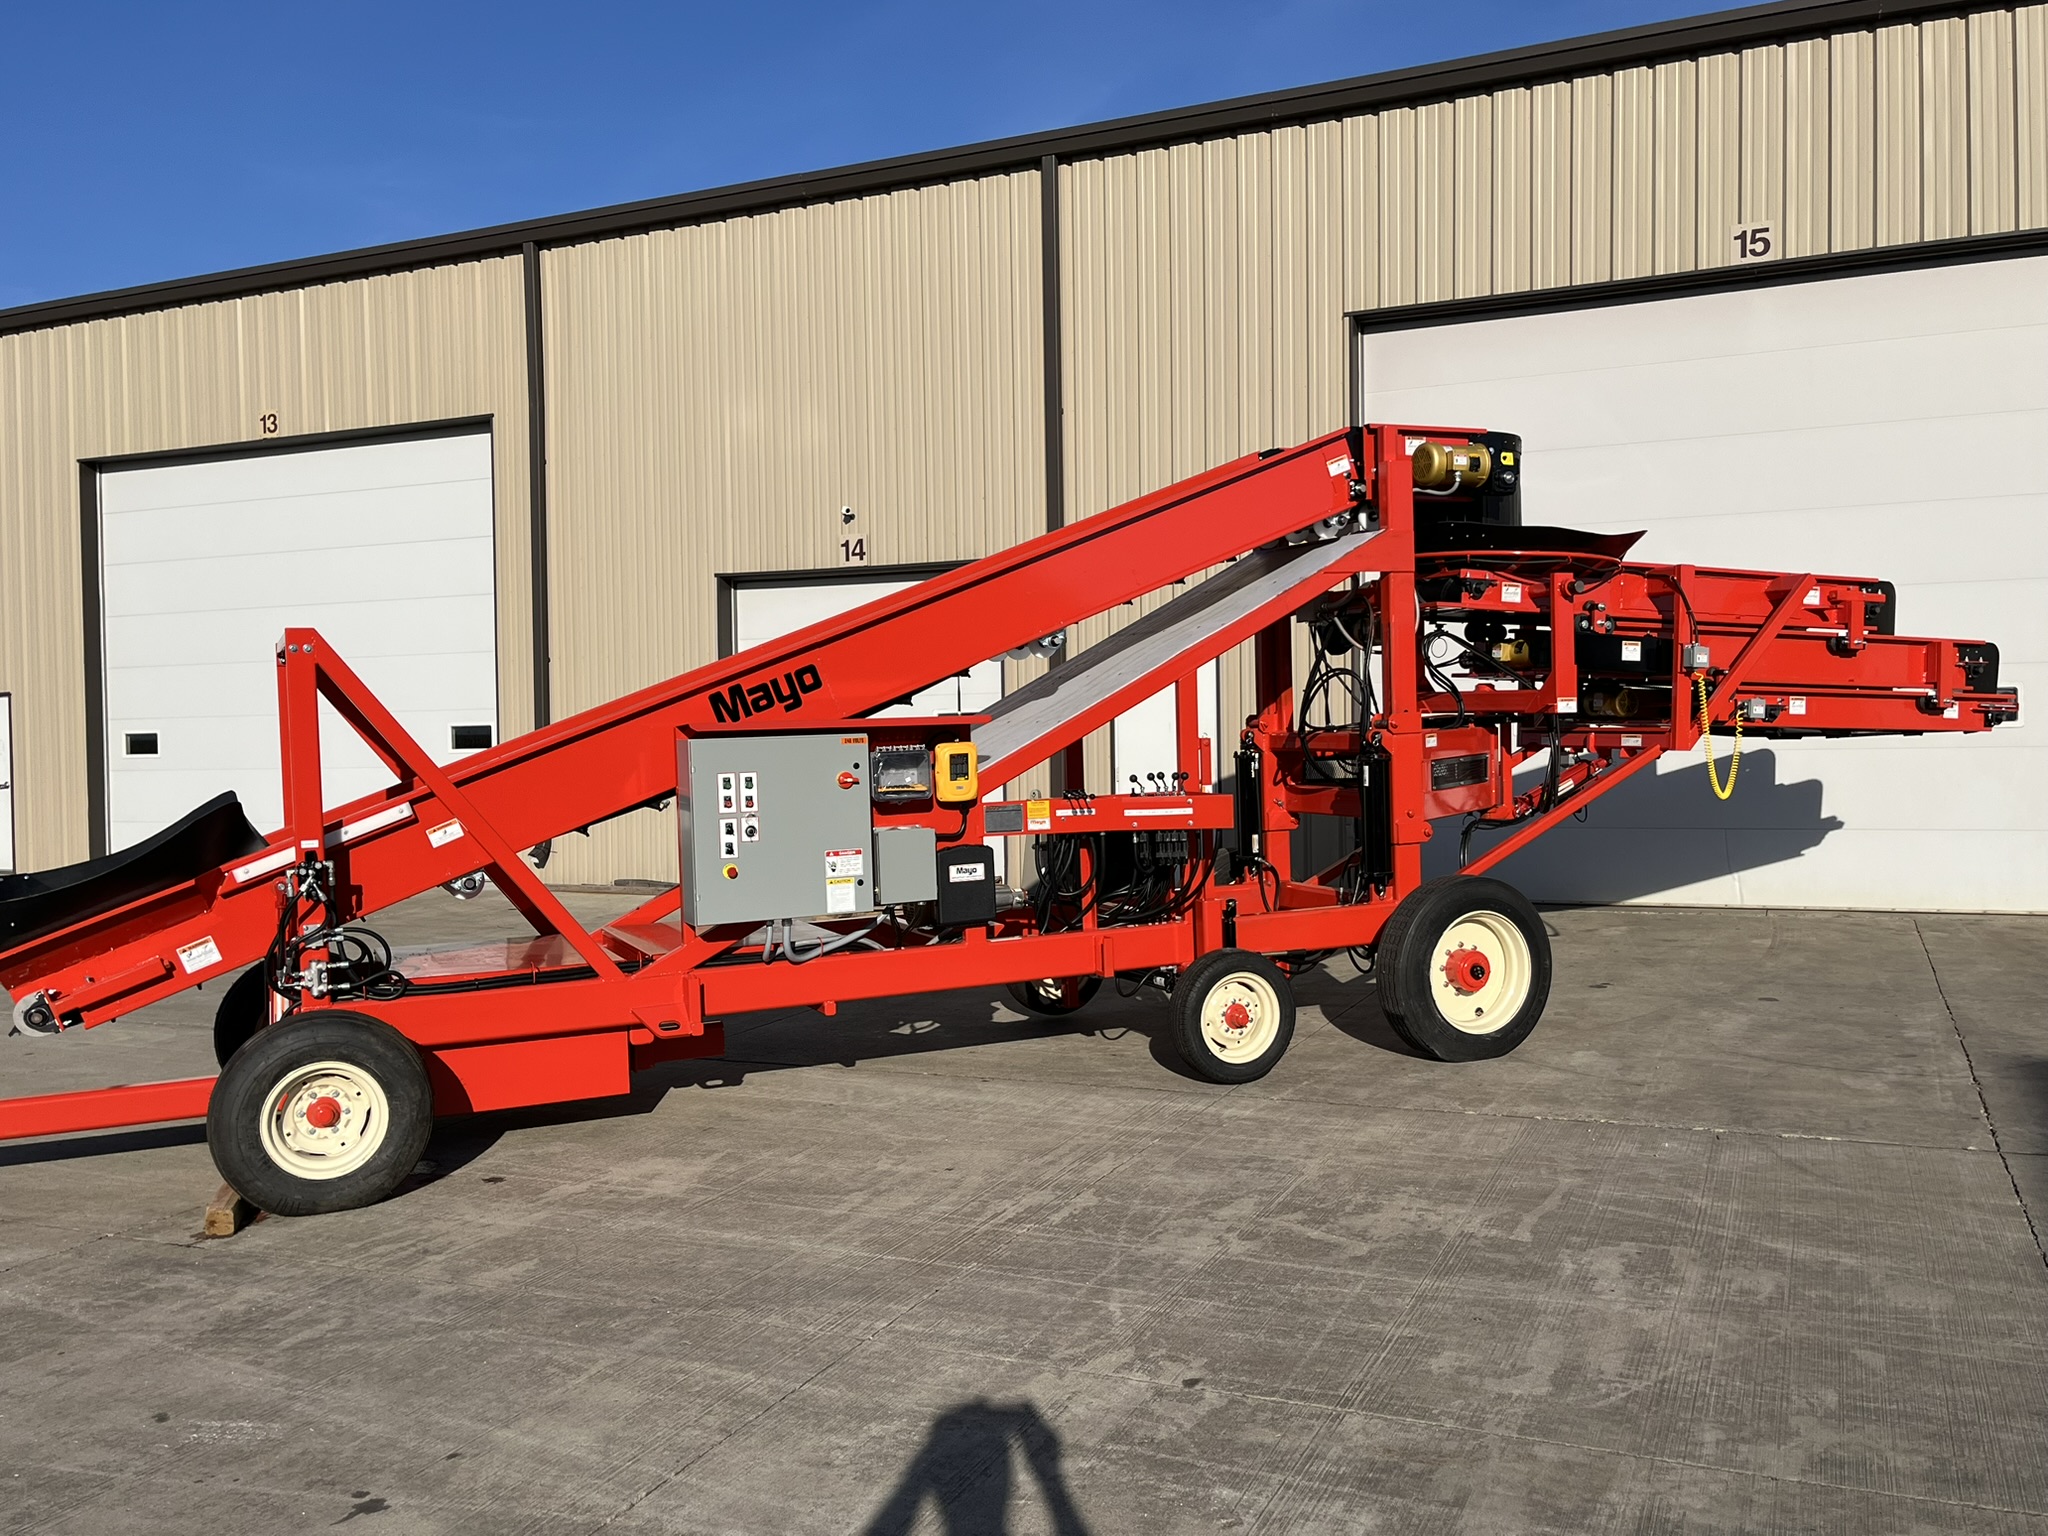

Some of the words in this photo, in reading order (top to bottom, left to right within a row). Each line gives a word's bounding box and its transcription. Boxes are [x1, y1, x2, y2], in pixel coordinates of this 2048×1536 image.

[1733, 227, 1771, 258] 15
[259, 413, 278, 434] 13
[841, 538, 866, 562] 14
[708, 663, 823, 724] Mayo
[956, 867, 978, 876] Mayo
